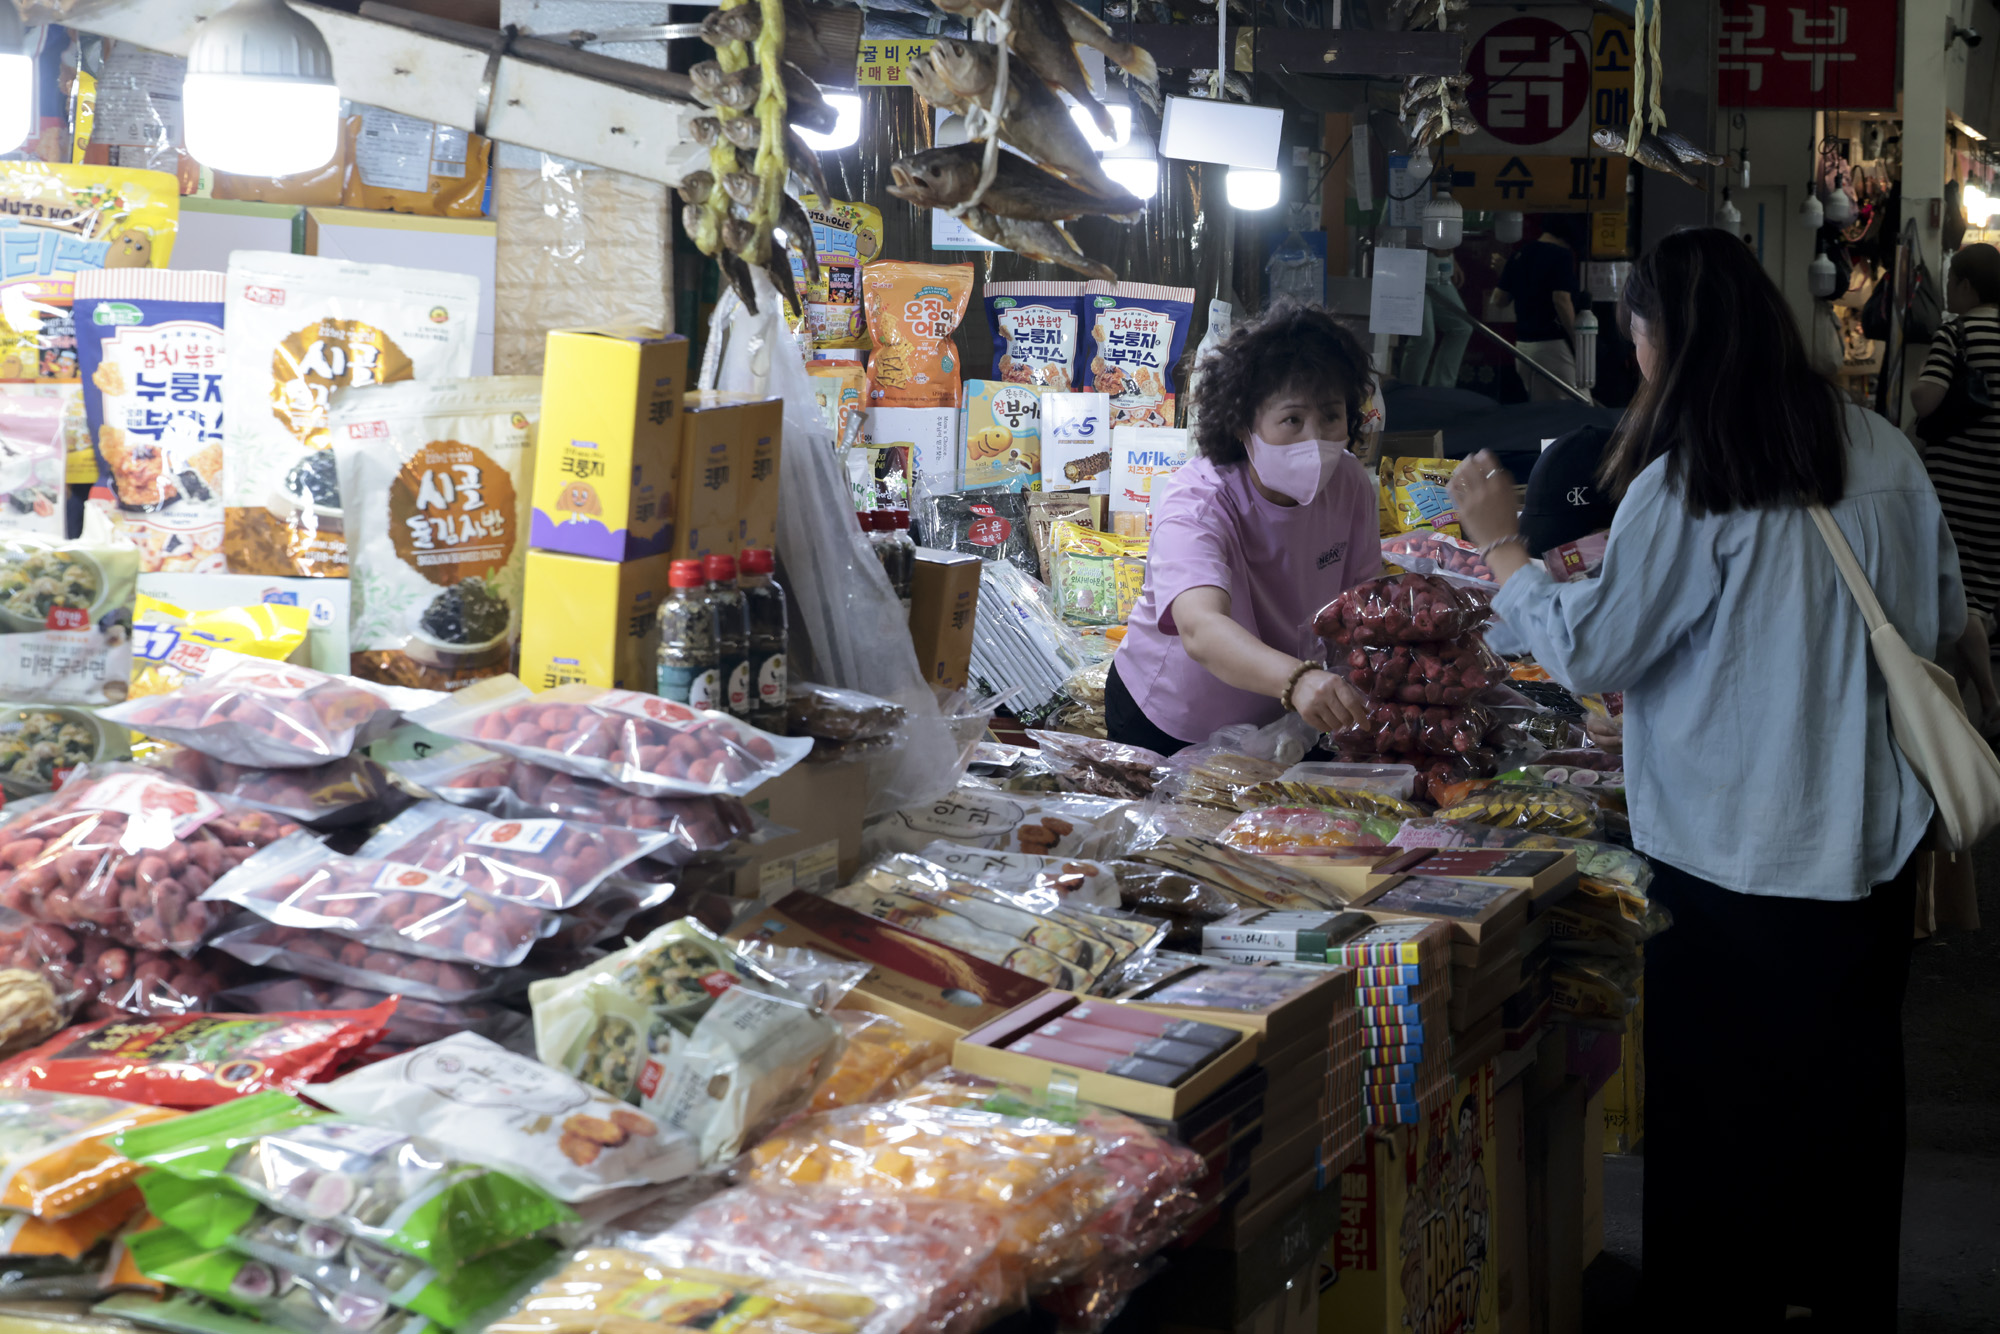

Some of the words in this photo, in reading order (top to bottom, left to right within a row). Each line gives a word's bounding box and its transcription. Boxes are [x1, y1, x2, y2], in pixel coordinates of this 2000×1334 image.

[1484, 36, 1576, 128] 닭
[1494, 156, 1608, 200] 슈퍼
[826, 216, 851, 229] HOLIC
[1013, 315, 1035, 327] 김치
[1037, 315, 1062, 329] 볶음밥
[1110, 317, 1132, 330] 김치
[1134, 319, 1159, 332] 볶음밥
[135, 344, 178, 368] 김치
[1004, 399, 1041, 428] 붕어
[561, 457, 605, 478] 크룽지
[1128, 451, 1171, 466] Milk
[1128, 466, 1154, 475] 치즈맛
[417, 465, 485, 510] 시골
[20, 654, 107, 681] 미역국라면
